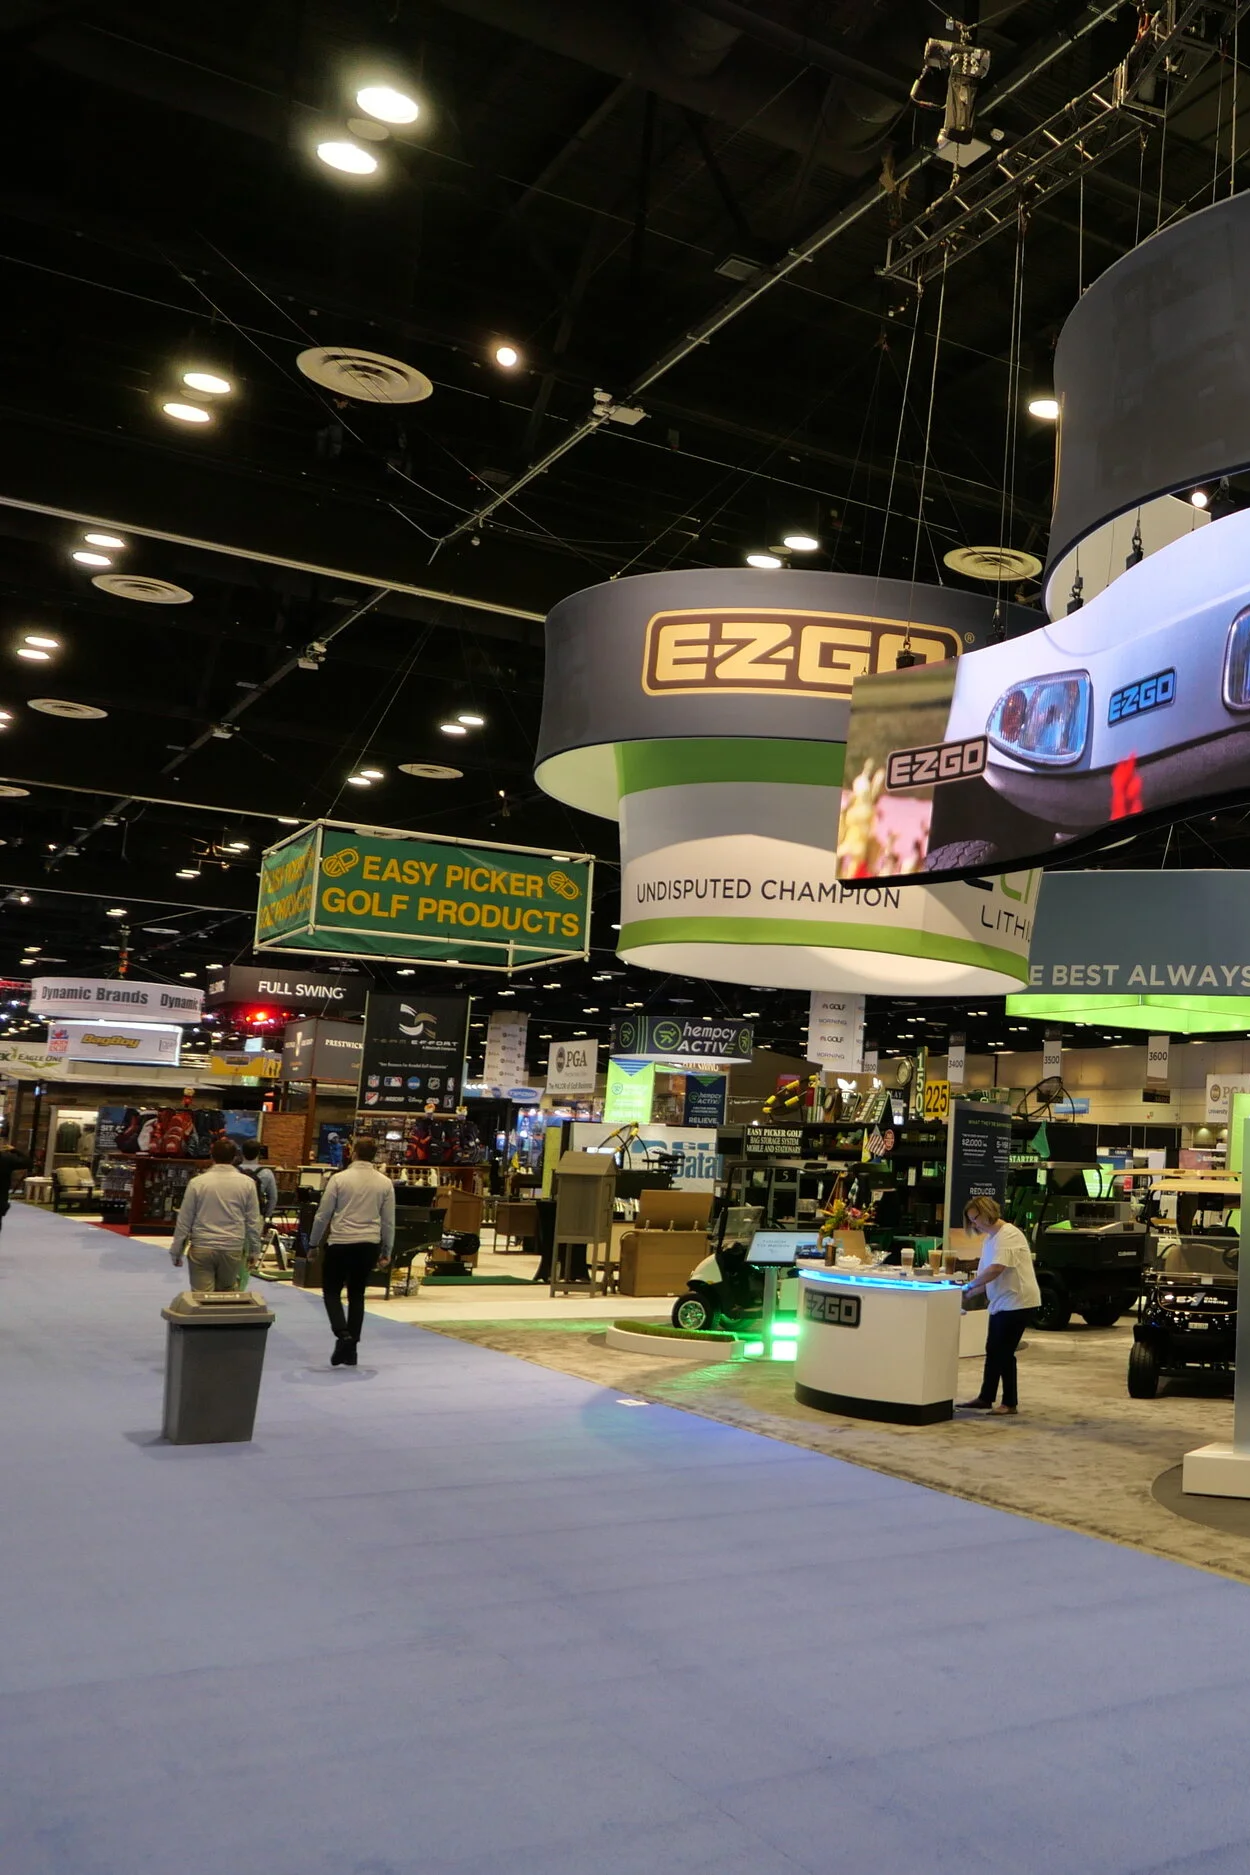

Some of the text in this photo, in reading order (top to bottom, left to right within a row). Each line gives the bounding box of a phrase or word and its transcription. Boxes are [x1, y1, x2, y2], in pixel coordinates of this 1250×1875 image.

[655, 622, 947, 684] EZGO
[1109, 672, 1174, 722] EZGO
[889, 739, 986, 786] EZGO
[362, 855, 544, 899] EASY PICKER
[636, 878, 901, 910] UNDISPUTED CHAMPION
[321, 886, 409, 919] GOLF
[417, 897, 581, 938] PRODUCTS
[981, 904, 1031, 943] LITHI
[1052, 964, 1119, 986] BEST
[42, 985, 149, 1005] Dynamic Brands
[258, 981, 344, 999] FULL SWING
[683, 1021, 737, 1041] hempcy
[81, 1033, 142, 1049] BagBoy
[677, 1040, 736, 1054] ACTIVE
[18, 1054, 44, 1062] EAGLE
[45, 1055, 63, 1063] ONE
[565, 1049, 588, 1068] PGA
[1044, 1056, 1060, 1064] 3500
[1148, 1051, 1168, 1062] 3600
[700, 1093, 723, 1101] hempcy
[925, 1084, 948, 1114] 225
[747, 1127, 803, 1138] EASY PICKER GOLF
[750, 1136, 799, 1146] BAG STORAGE SYSTEM
[747, 1144, 764, 1152] MOBILE
[1009, 1155, 1039, 1163] STARTER
[782, 1171, 789, 1181] 5
[969, 1187, 996, 1195] REDUCED
